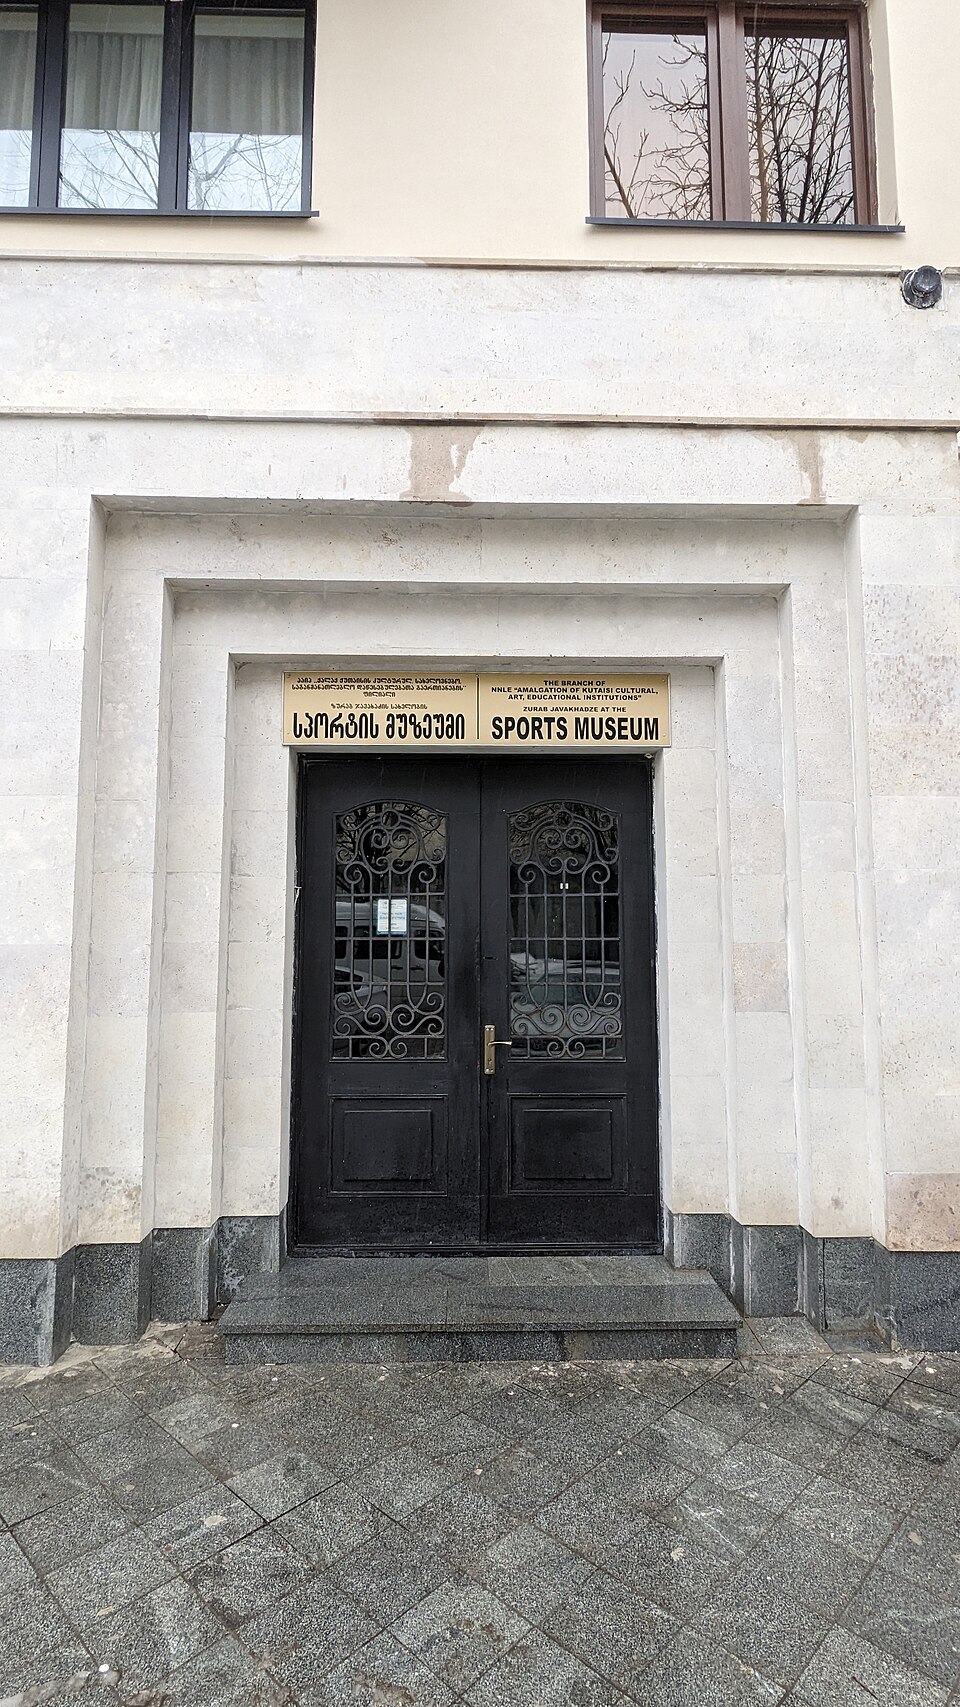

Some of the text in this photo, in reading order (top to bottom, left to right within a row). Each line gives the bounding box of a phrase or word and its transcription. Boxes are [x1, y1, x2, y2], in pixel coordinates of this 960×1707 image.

[293, 713, 465, 739] სპორტის მუზეუმი
[492, 716, 659, 740] SPORTS MUSEUM
